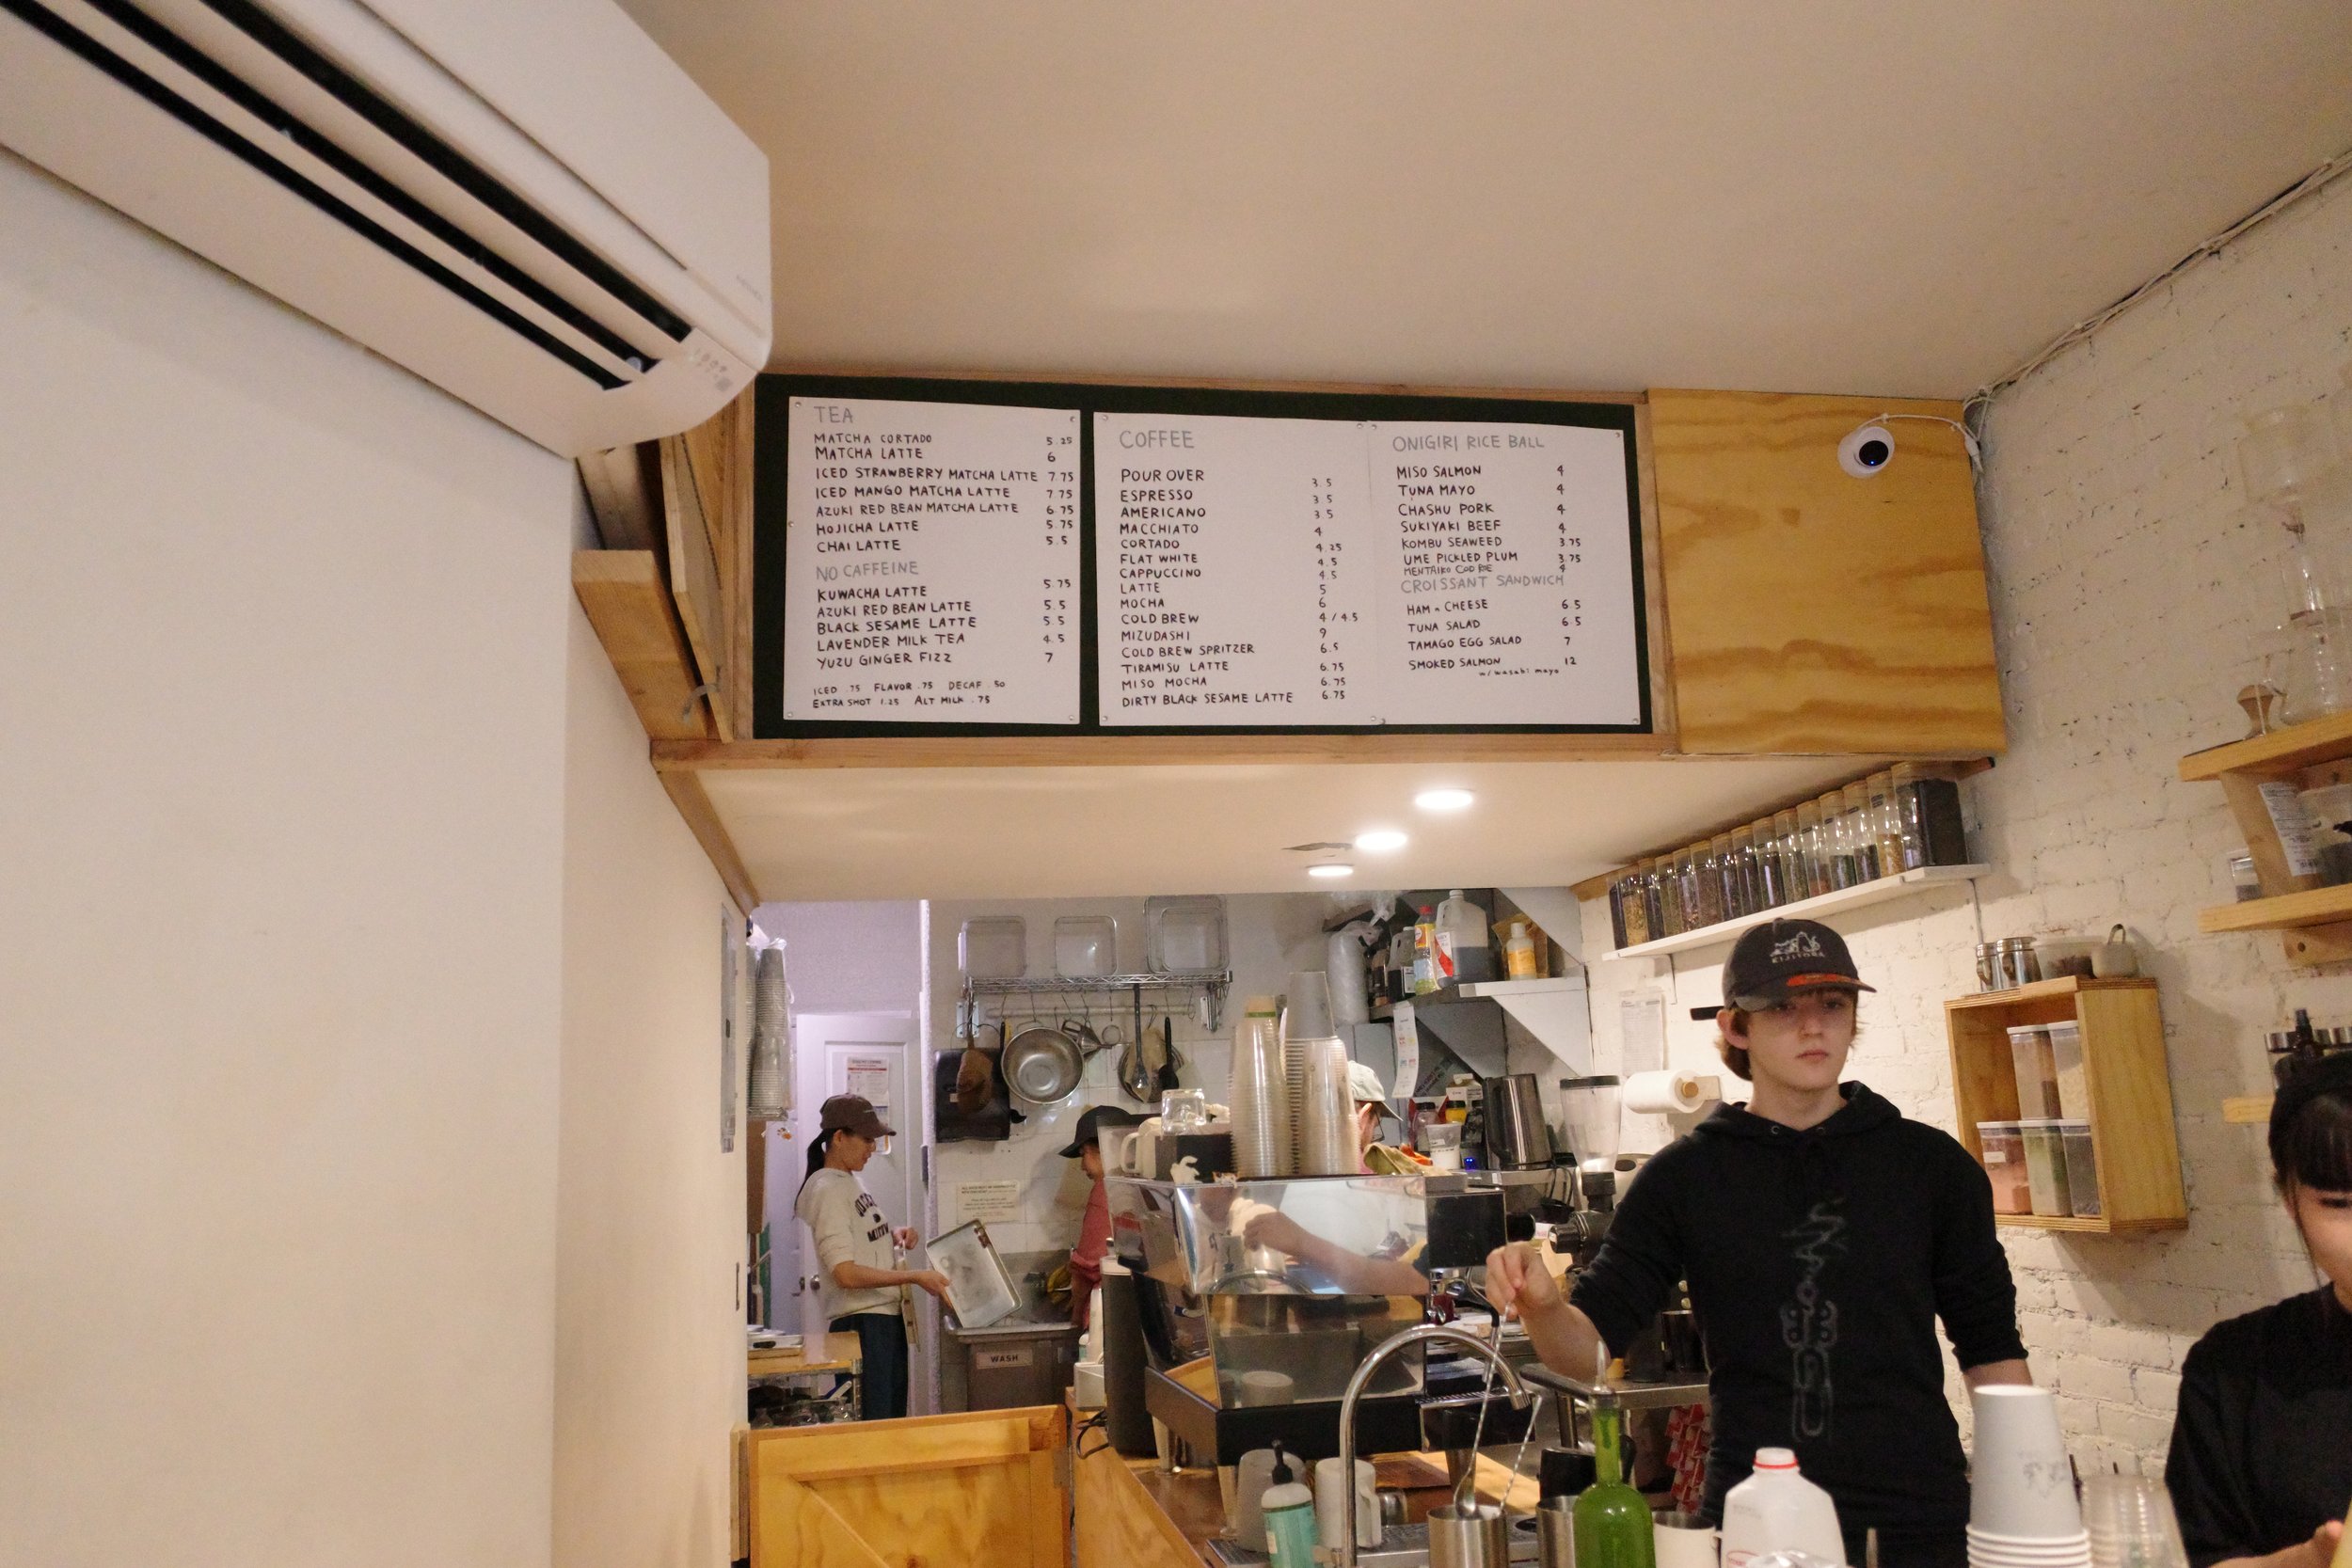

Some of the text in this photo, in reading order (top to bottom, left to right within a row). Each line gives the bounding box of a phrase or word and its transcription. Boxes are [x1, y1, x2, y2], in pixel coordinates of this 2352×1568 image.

[814, 406, 853, 423] TEA
[814, 433, 870, 444] MATCHA
[881, 434, 931, 444] CORTADO
[1120, 430, 1194, 449] COFFEE
[1392, 435, 1545, 451] ONIGIRI RICE BALL
[816, 446, 1056, 462] MATCHA LATTE 6
[817, 467, 848, 479] ICED
[855, 467, 943, 479] STRAWBERRY
[949, 469, 994, 480] MATCHA
[1001, 470, 1038, 482] LATTE
[1121, 468, 1161, 483] POUR
[1167, 469, 1203, 481] OVER
[1397, 465, 1564, 480] MISO SALMON 4
[817, 487, 847, 499] ICED
[854, 485, 902, 497] MANGO
[910, 485, 961, 497] MATCHA
[968, 487, 1009, 498] LATTE
[1120, 489, 1193, 502] ESPRESSO
[1398, 483, 1565, 499] TUNA MAYO 4
[817, 506, 852, 517] AZUKI
[860, 504, 884, 515] RED
[891, 503, 922, 515] BEAN
[927, 502, 975, 513] MATCHA
[979, 503, 1018, 513] LATTE
[1121, 507, 1205, 518] AMERICANO
[1398, 503, 1565, 515] CHASHU PORK 4
[817, 522, 873, 535] HOJICHA
[880, 520, 918, 532] LATTE
[1120, 523, 1322, 536] MACCHIATO 4
[1401, 520, 1565, 533] SUKIYAKI BEEF 4
[818, 541, 850, 553] CHAI
[856, 540, 900, 551] LATTE
[1121, 539, 1180, 548] CORTADO
[1402, 538, 1441, 550] KOMBU
[1448, 536, 1502, 546] SEAWEED
[1120, 554, 1152, 564] FLAT
[1159, 554, 1197, 563] WHITE
[1404, 554, 1429, 564] UME
[1437, 553, 1482, 563] PICKLED
[1486, 551, 1518, 562] PLUM
[817, 561, 918, 582] NO CAFFEINE
[1120, 568, 1200, 578] CAPPUCCINO
[1560, 563, 1565, 573] 4
[1120, 582, 1326, 594] LATTE 5
[1402, 575, 1564, 594] CROISSANT SANDWICH
[818, 588, 880, 603] KUWACHA
[885, 586, 927, 597] LATTE
[818, 606, 856, 618] AZUKI
[864, 605, 887, 616] RED
[893, 602, 926, 615] BEAN
[930, 601, 971, 612] LATTE
[1120, 597, 1326, 609] MOCHA 6
[1407, 605, 1430, 615] HAM
[1445, 599, 1487, 611] CHEESE
[818, 623, 859, 635] BLACK
[866, 618, 919, 632] SESAME
[930, 617, 976, 628] LATTE
[1121, 613, 1156, 625] COLD
[1162, 613, 1199, 624] BREW
[1407, 623, 1438, 632] TUNA
[1446, 620, 1480, 630] SALAD
[1121, 627, 1327, 641] MIZUDASHI 9
[818, 634, 889, 652] LAVENDER
[898, 635, 927, 646] MILK
[934, 633, 964, 644] TEA
[1408, 636, 1570, 651] TAMAGO EGG SALAD 7
[1121, 647, 1153, 658] COLD
[1159, 646, 1192, 657] BREW
[1200, 643, 1254, 656] SPRITZER
[817, 652, 1053, 670] YUZU GINGER FIZZ 7
[1121, 663, 1180, 673] TIRAMISU
[1190, 661, 1229, 672] LATTE
[1409, 657, 1577, 670] SMOKED SALMON 12
[814, 687, 837, 695] ICED
[874, 682, 912, 691] FLAVOR
[948, 681, 981, 690] DECAF
[1121, 679, 1154, 690] MISO
[1166, 677, 1206, 688] MOCHA
[1122, 695, 1156, 707] DIRTY
[1163, 694, 1197, 705] BLACK
[1204, 693, 1248, 704] SESAME
[1255, 692, 1293, 703] LATTE
[991, 1354, 1018, 1363] WASH
